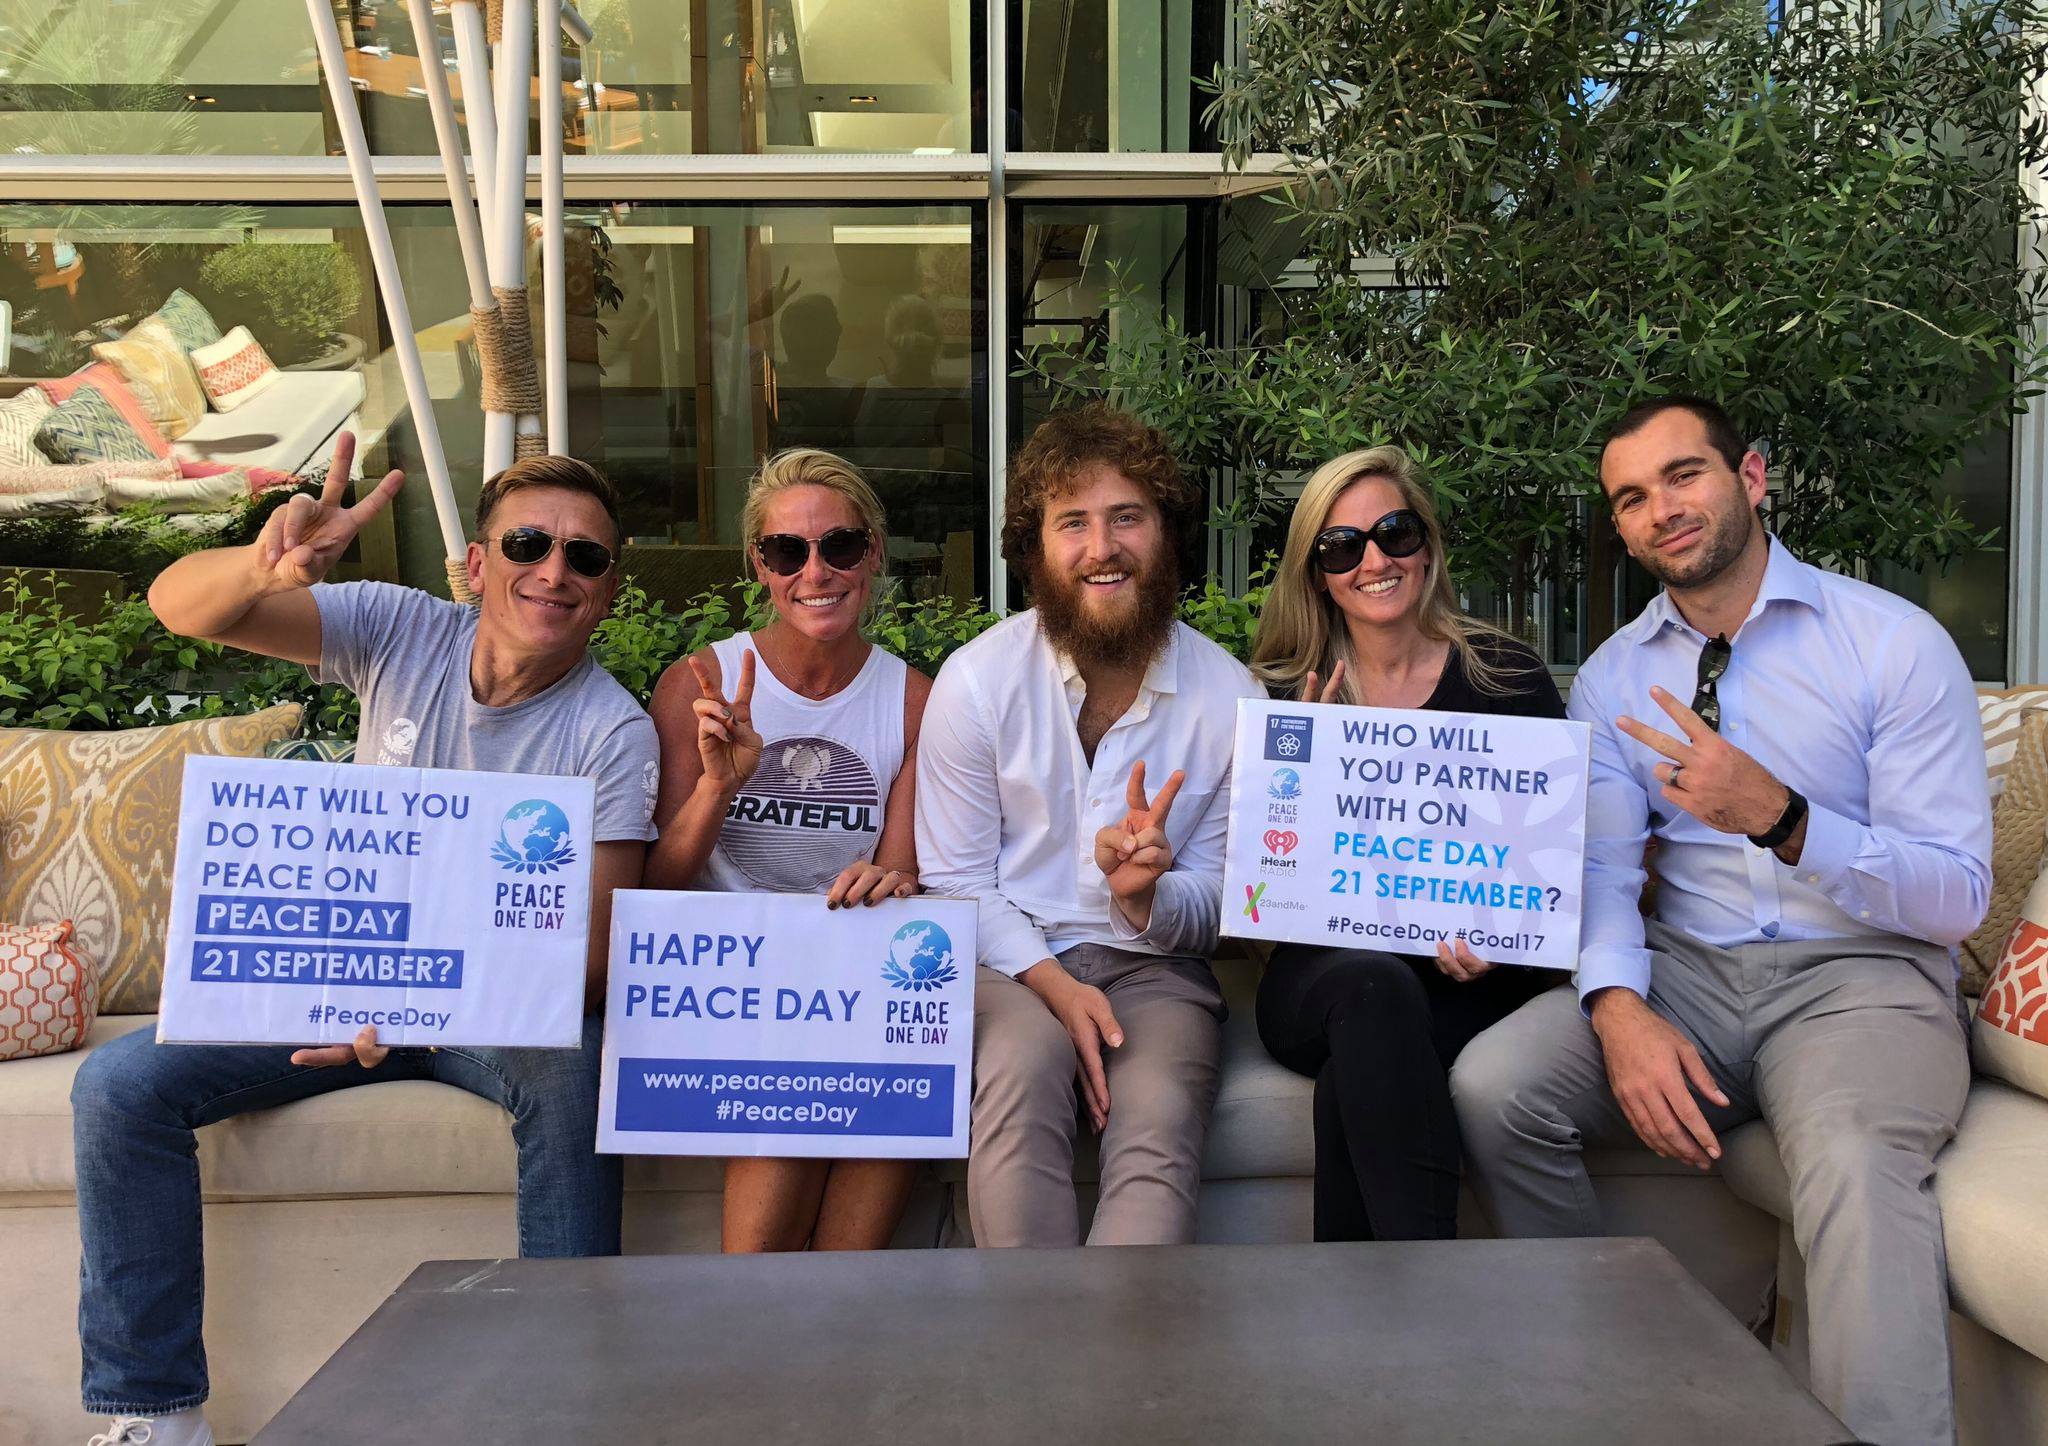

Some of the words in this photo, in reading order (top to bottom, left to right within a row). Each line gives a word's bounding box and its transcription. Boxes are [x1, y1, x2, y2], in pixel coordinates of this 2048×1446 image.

[1270, 718, 1280, 729] 17
[1342, 719, 1417, 748] WHO
[1429, 726, 1494, 754] WILL
[1338, 756, 1402, 785] YOU
[1415, 762, 1550, 795] PARTNER
[211, 781, 309, 811] WHAT
[319, 787, 389, 816] WILL
[401, 792, 470, 820] YOU
[1268, 803, 1298, 815] PEACE
[1336, 793, 1407, 823] WITH
[1418, 800, 1468, 828] ON
[1267, 815, 1282, 823] ONE
[1284, 816, 1297, 824] DAY
[206, 821, 259, 849] DO
[271, 824, 314, 851] TO
[325, 828, 422, 856] MAKE
[1333, 831, 1433, 864] PEACE
[1444, 840, 1511, 869] DAY
[1259, 866, 1297, 878] RADIO
[1260, 855, 1297, 868] iHeart
[202, 861, 313, 891] PEACE
[324, 866, 378, 893] ON
[1329, 869, 1362, 895] 21
[1374, 872, 1562, 912] SEPTEMBER?
[495, 882, 566, 909] PEACE
[208, 902, 320, 932] PEACE
[330, 907, 402, 935] DAY
[494, 910, 526, 929] ONE
[534, 911, 565, 930] DAY
[628, 931, 766, 968] HAPPY
[1454, 928, 1545, 951] #Goal17
[201, 949, 240, 976] 21
[253, 949, 453, 983] SEPTEMBER?
[625, 984, 761, 1020] PEACE
[775, 988, 862, 1022] DAY
[885, 1000, 949, 1025] PEACE
[307, 1004, 452, 1032] #PeaceDay
[885, 1026, 915, 1044] ONE
[921, 1027, 948, 1045] DAY
[642, 1071, 932, 1099] www.peaceoneday.org
[716, 1099, 858, 1127] #PeaceDay
